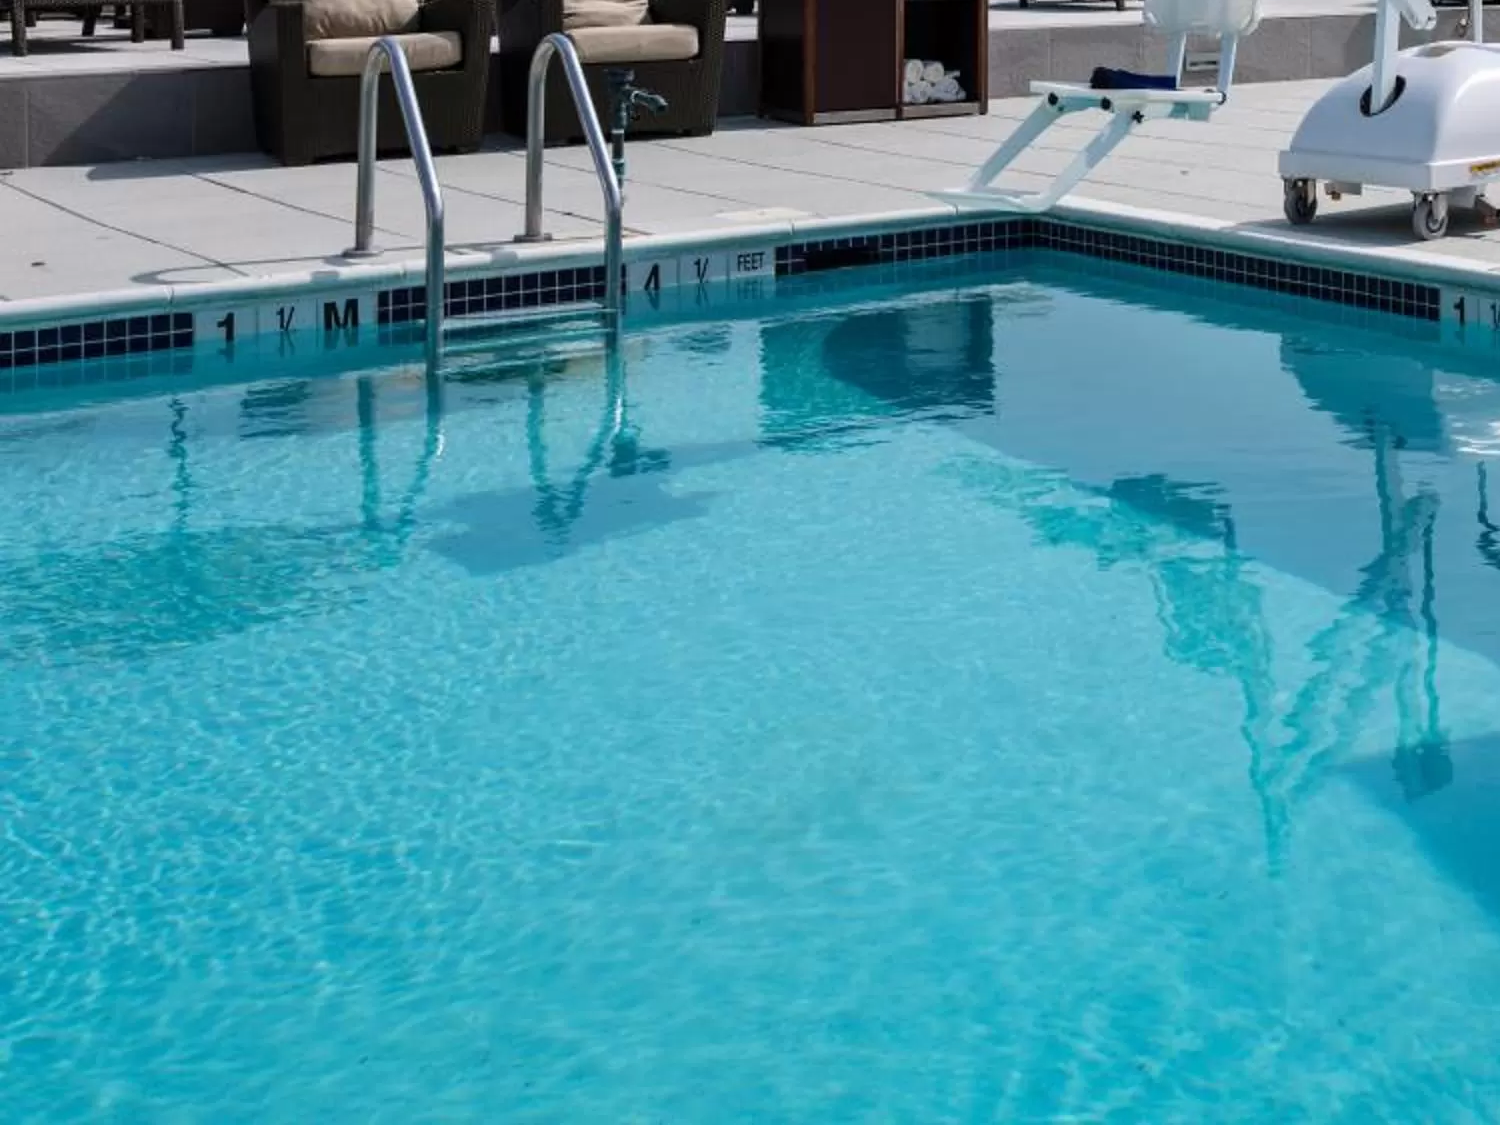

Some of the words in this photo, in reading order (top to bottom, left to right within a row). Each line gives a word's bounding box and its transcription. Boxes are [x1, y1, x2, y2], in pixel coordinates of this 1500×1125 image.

[737, 251, 765, 272] FEET
[217, 312, 234, 341] 1
[323, 298, 359, 331] M
[1453, 296, 1465, 326] 1
